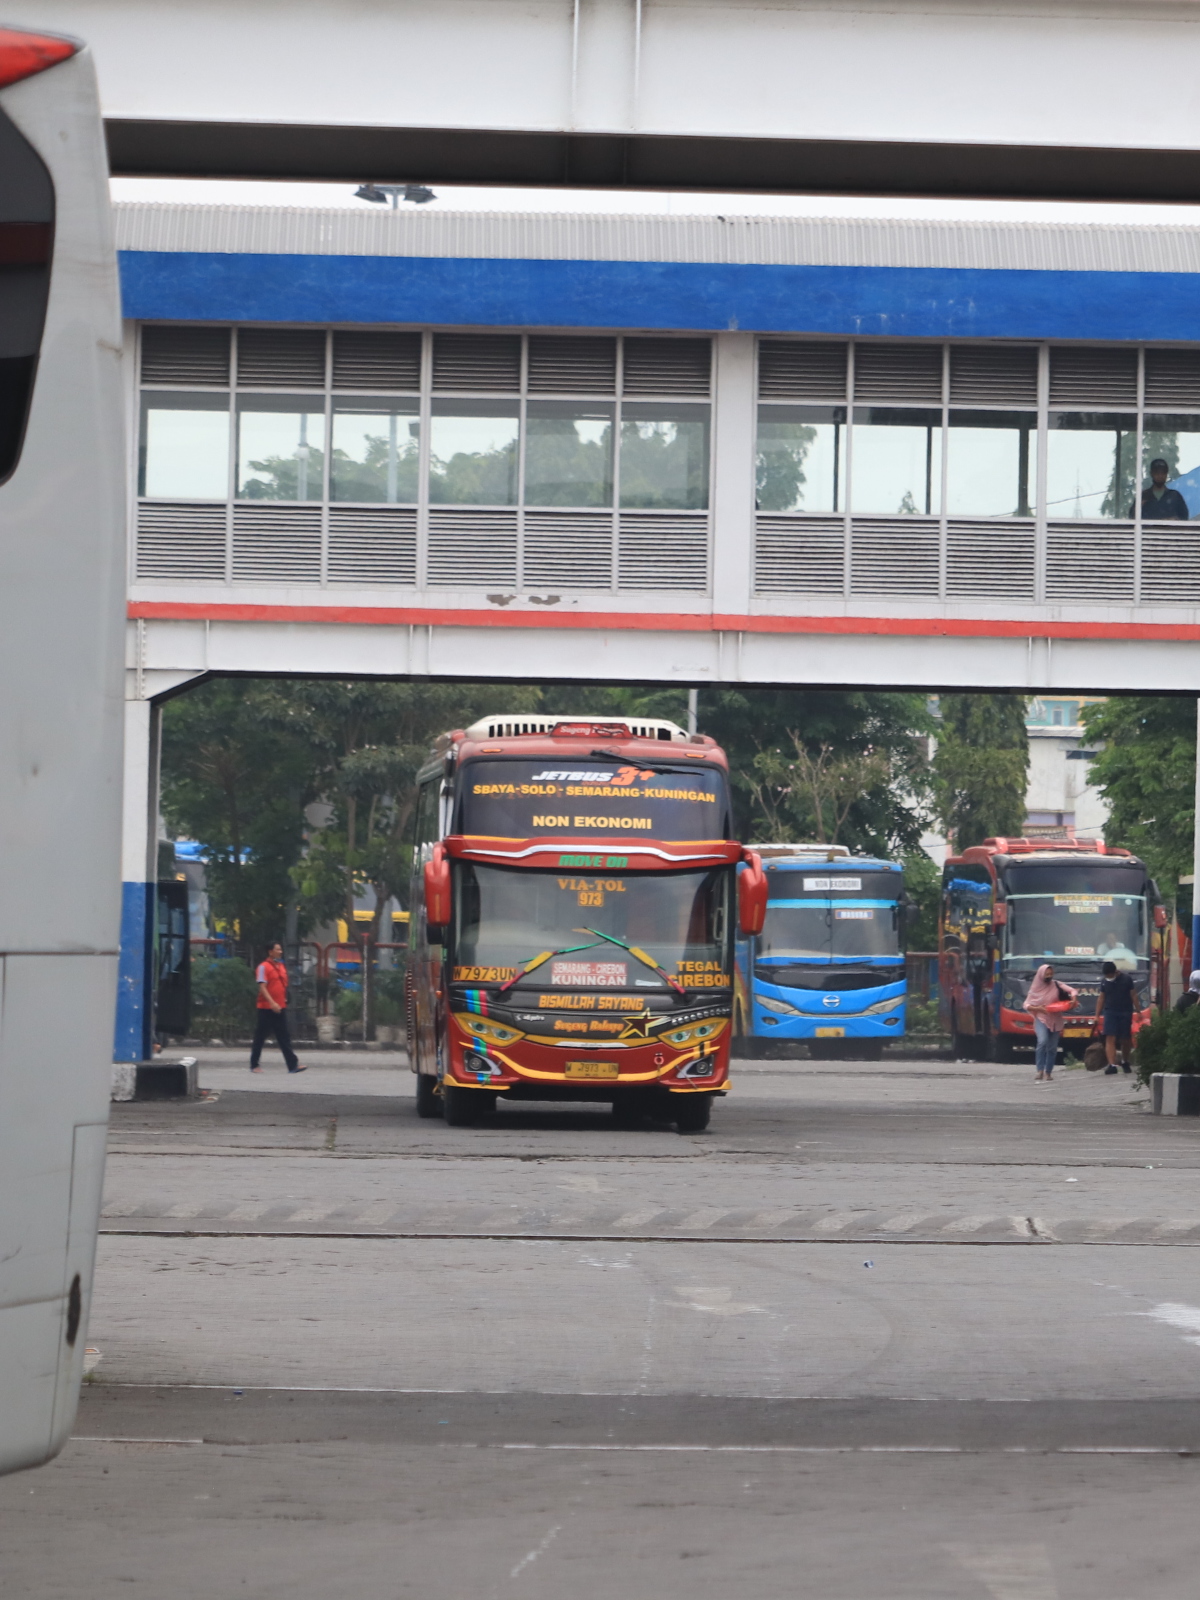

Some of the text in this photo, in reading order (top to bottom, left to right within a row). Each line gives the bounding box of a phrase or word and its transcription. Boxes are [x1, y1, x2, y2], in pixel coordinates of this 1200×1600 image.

[532, 771, 614, 782] JETBUS
[473, 784, 556, 795] SBAYA-SOLO
[566, 786, 716, 803] SEMARANG-KUNINGAN
[532, 815, 652, 830] NON EKONOMI
[557, 879, 627, 892] VIA-TOL
[580, 892, 602, 906] 973
[553, 963, 591, 974] SEMARANG
[596, 964, 626, 974] CIREBON
[676, 961, 722, 972] TEGAL
[552, 975, 627, 986] KUNINGAN
[538, 995, 645, 1010] BISMILLAH SAYANG
